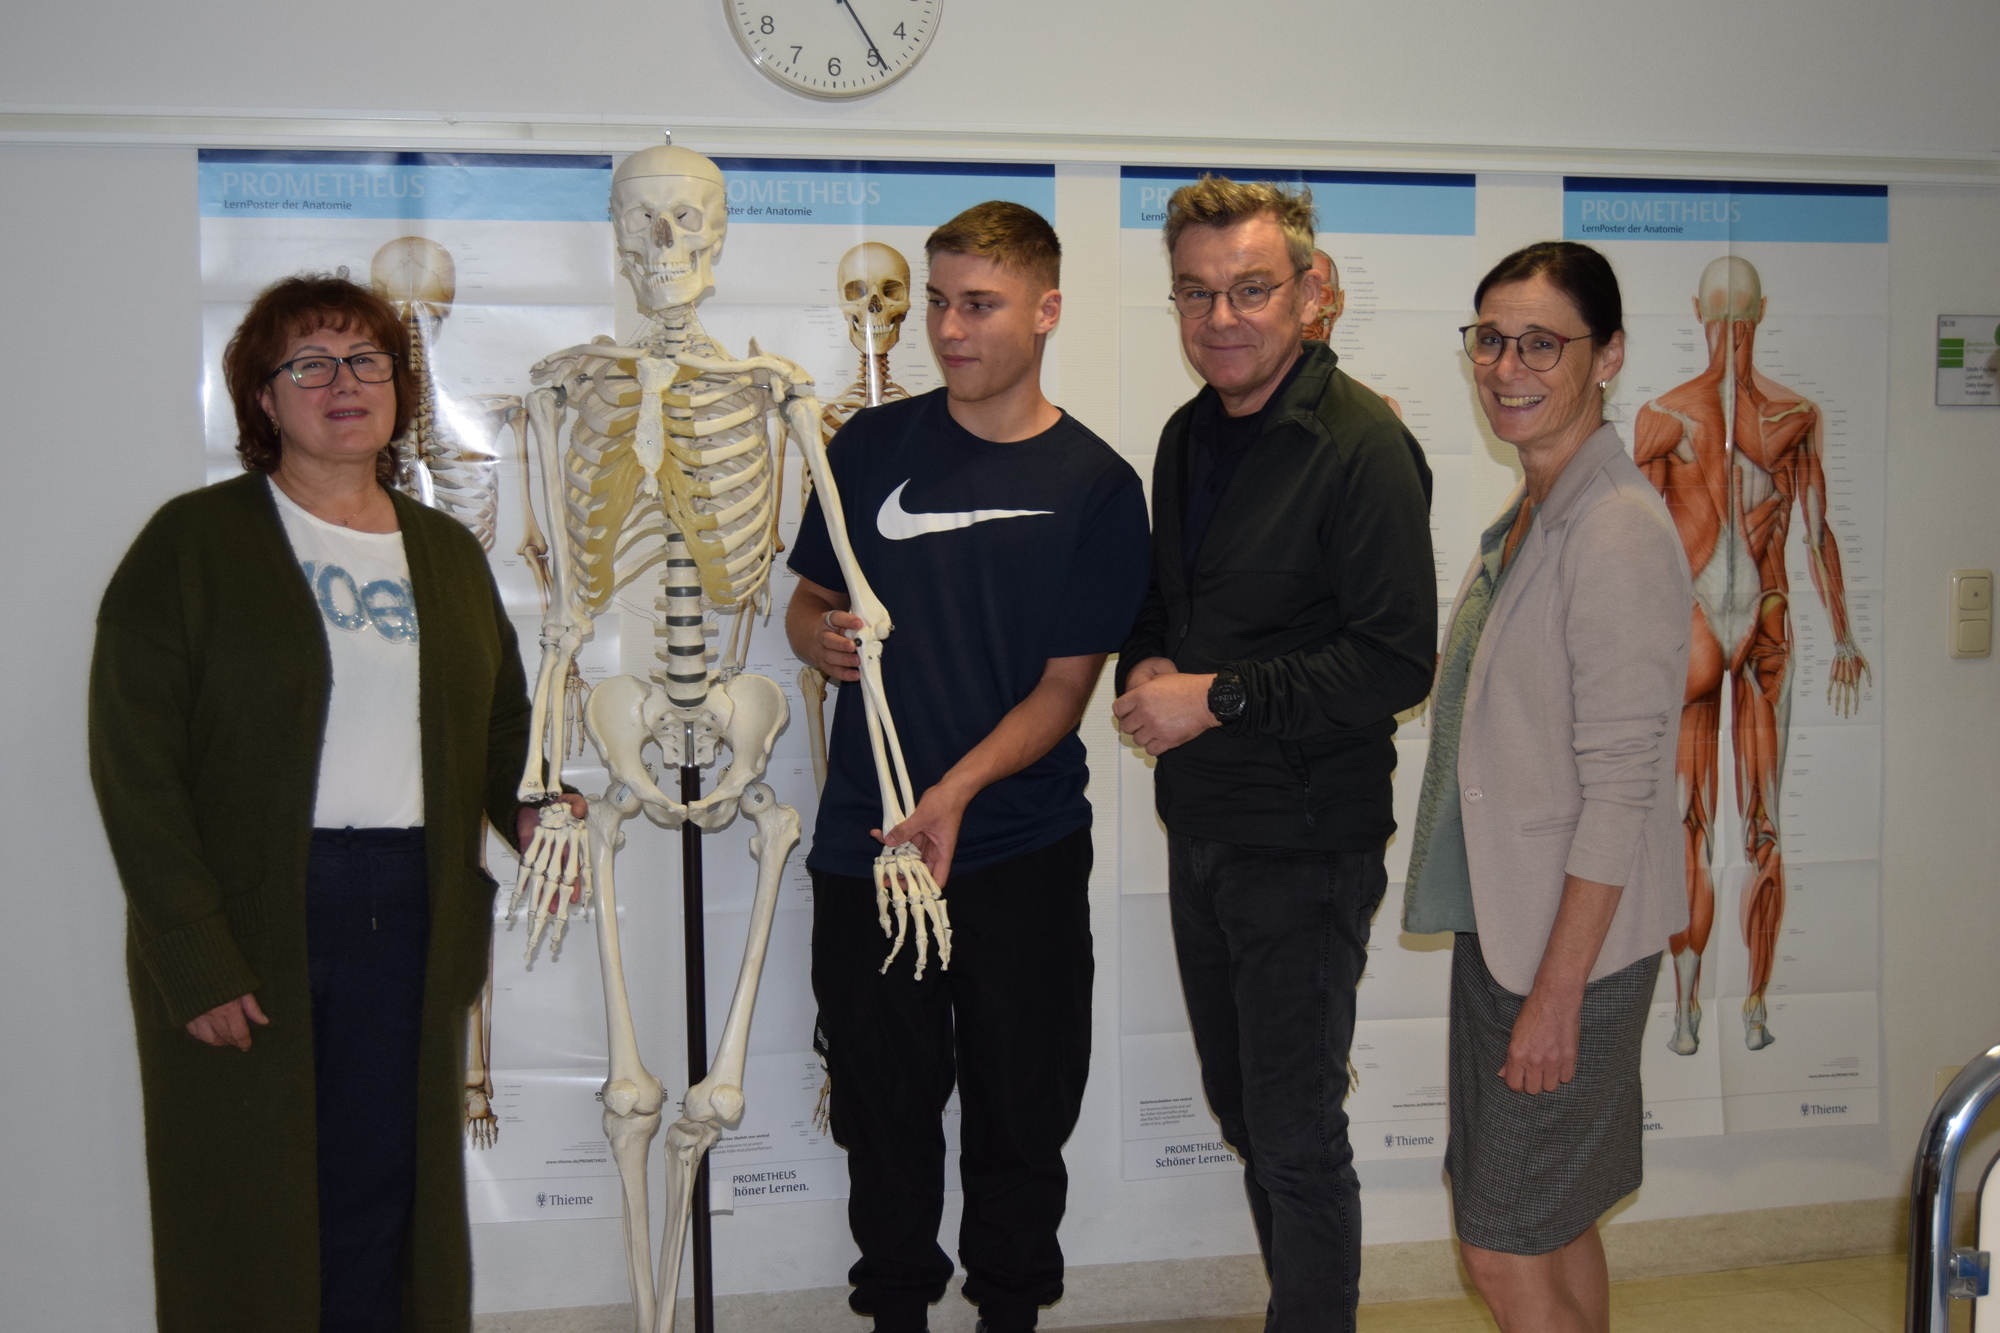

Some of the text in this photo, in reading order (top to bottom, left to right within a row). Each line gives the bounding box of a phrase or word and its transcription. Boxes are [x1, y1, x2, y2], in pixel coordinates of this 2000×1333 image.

[760, 15, 775, 35] 8
[892, 21, 907, 41] 4
[790, 45, 803, 64] 7
[866, 48, 882, 68] 5
[827, 57, 842, 77] 6
[222, 172, 426, 198] PROMETHEUS
[727, 179, 881, 205] OMETHEUS
[224, 200, 352, 210] LernPoster der Anatomie
[746, 206, 763, 216] der
[765, 206, 812, 216] Anatomie
[1581, 200, 1741, 223] PROMETHEUS
[1582, 224, 1683, 234] LernPoster der Anatomie
[1812, 1104, 1847, 1115] Thieme
[1164, 1141, 1224, 1154] PROMETHEUS
[1395, 1135, 1434, 1146] Thieme
[1155, 1153, 1236, 1168] Schöner Lernen.
[732, 1170, 796, 1184] PROMETHEUS
[734, 1182, 810, 1196] höner Lernen.
[548, 1194, 594, 1206] Thieme
